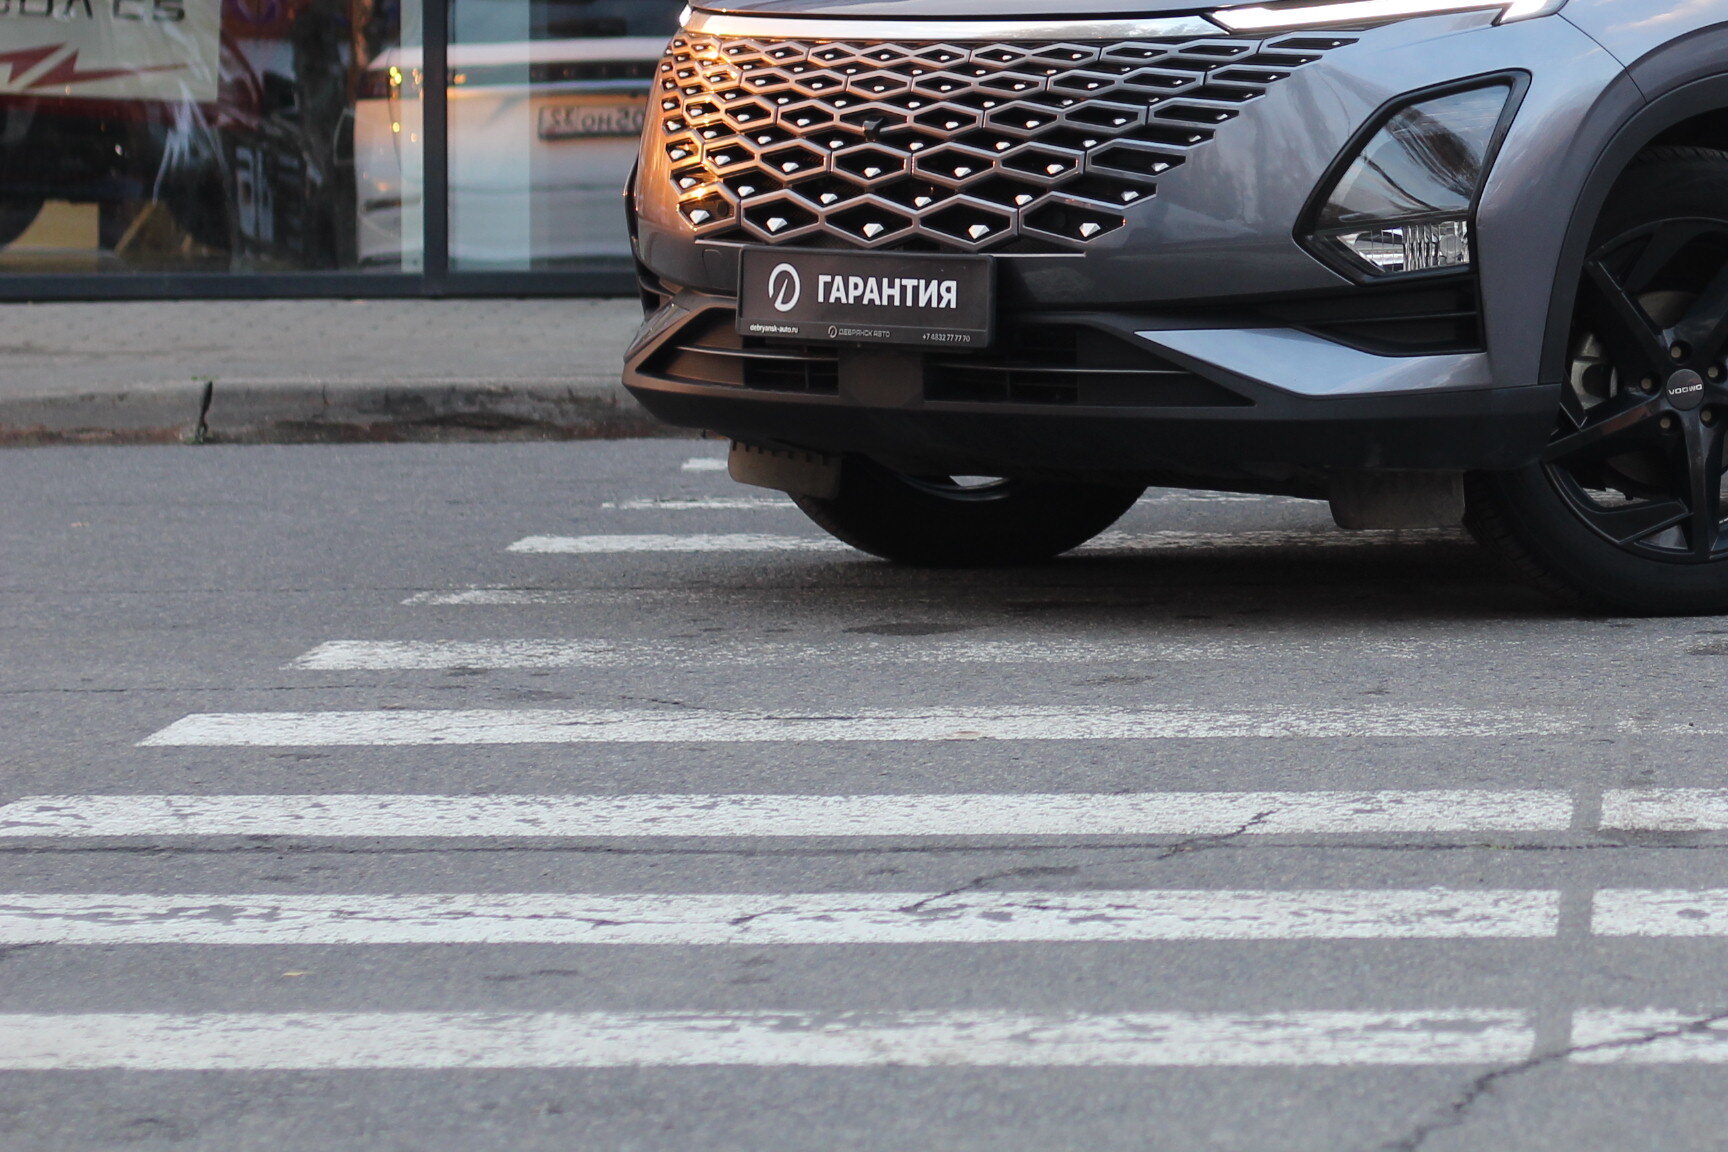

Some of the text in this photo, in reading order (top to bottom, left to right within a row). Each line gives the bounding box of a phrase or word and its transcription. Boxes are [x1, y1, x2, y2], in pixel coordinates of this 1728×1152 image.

[817, 274, 957, 309] ГАРАНТИЯ
[749, 323, 798, 334] debryansk-auto.ru
[1668, 384, 1702, 395] OMODA
